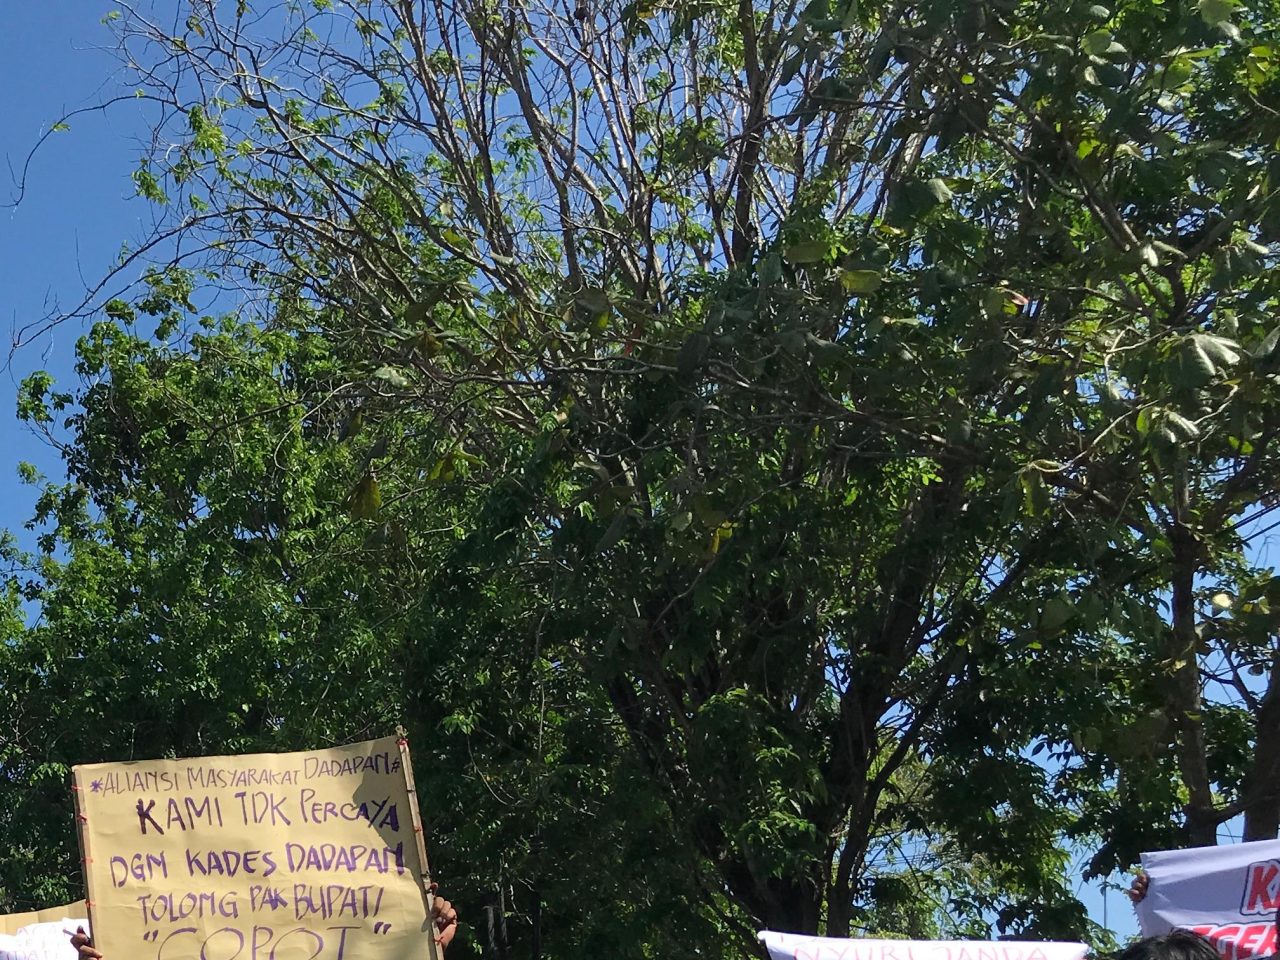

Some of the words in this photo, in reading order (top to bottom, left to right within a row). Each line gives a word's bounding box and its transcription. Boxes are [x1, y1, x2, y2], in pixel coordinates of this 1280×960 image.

[187, 766, 301, 790] MASYARAKAT
[136, 797, 223, 835] KAMI
[234, 791, 292, 827] TDK
[110, 850, 168, 888] DGN
[185, 849, 277, 877] KADES
[286, 841, 405, 875] DADAPAN
[137, 886, 239, 927] TOLONG
[249, 884, 288, 912] PAK
[292, 882, 385, 921] BUPATI
